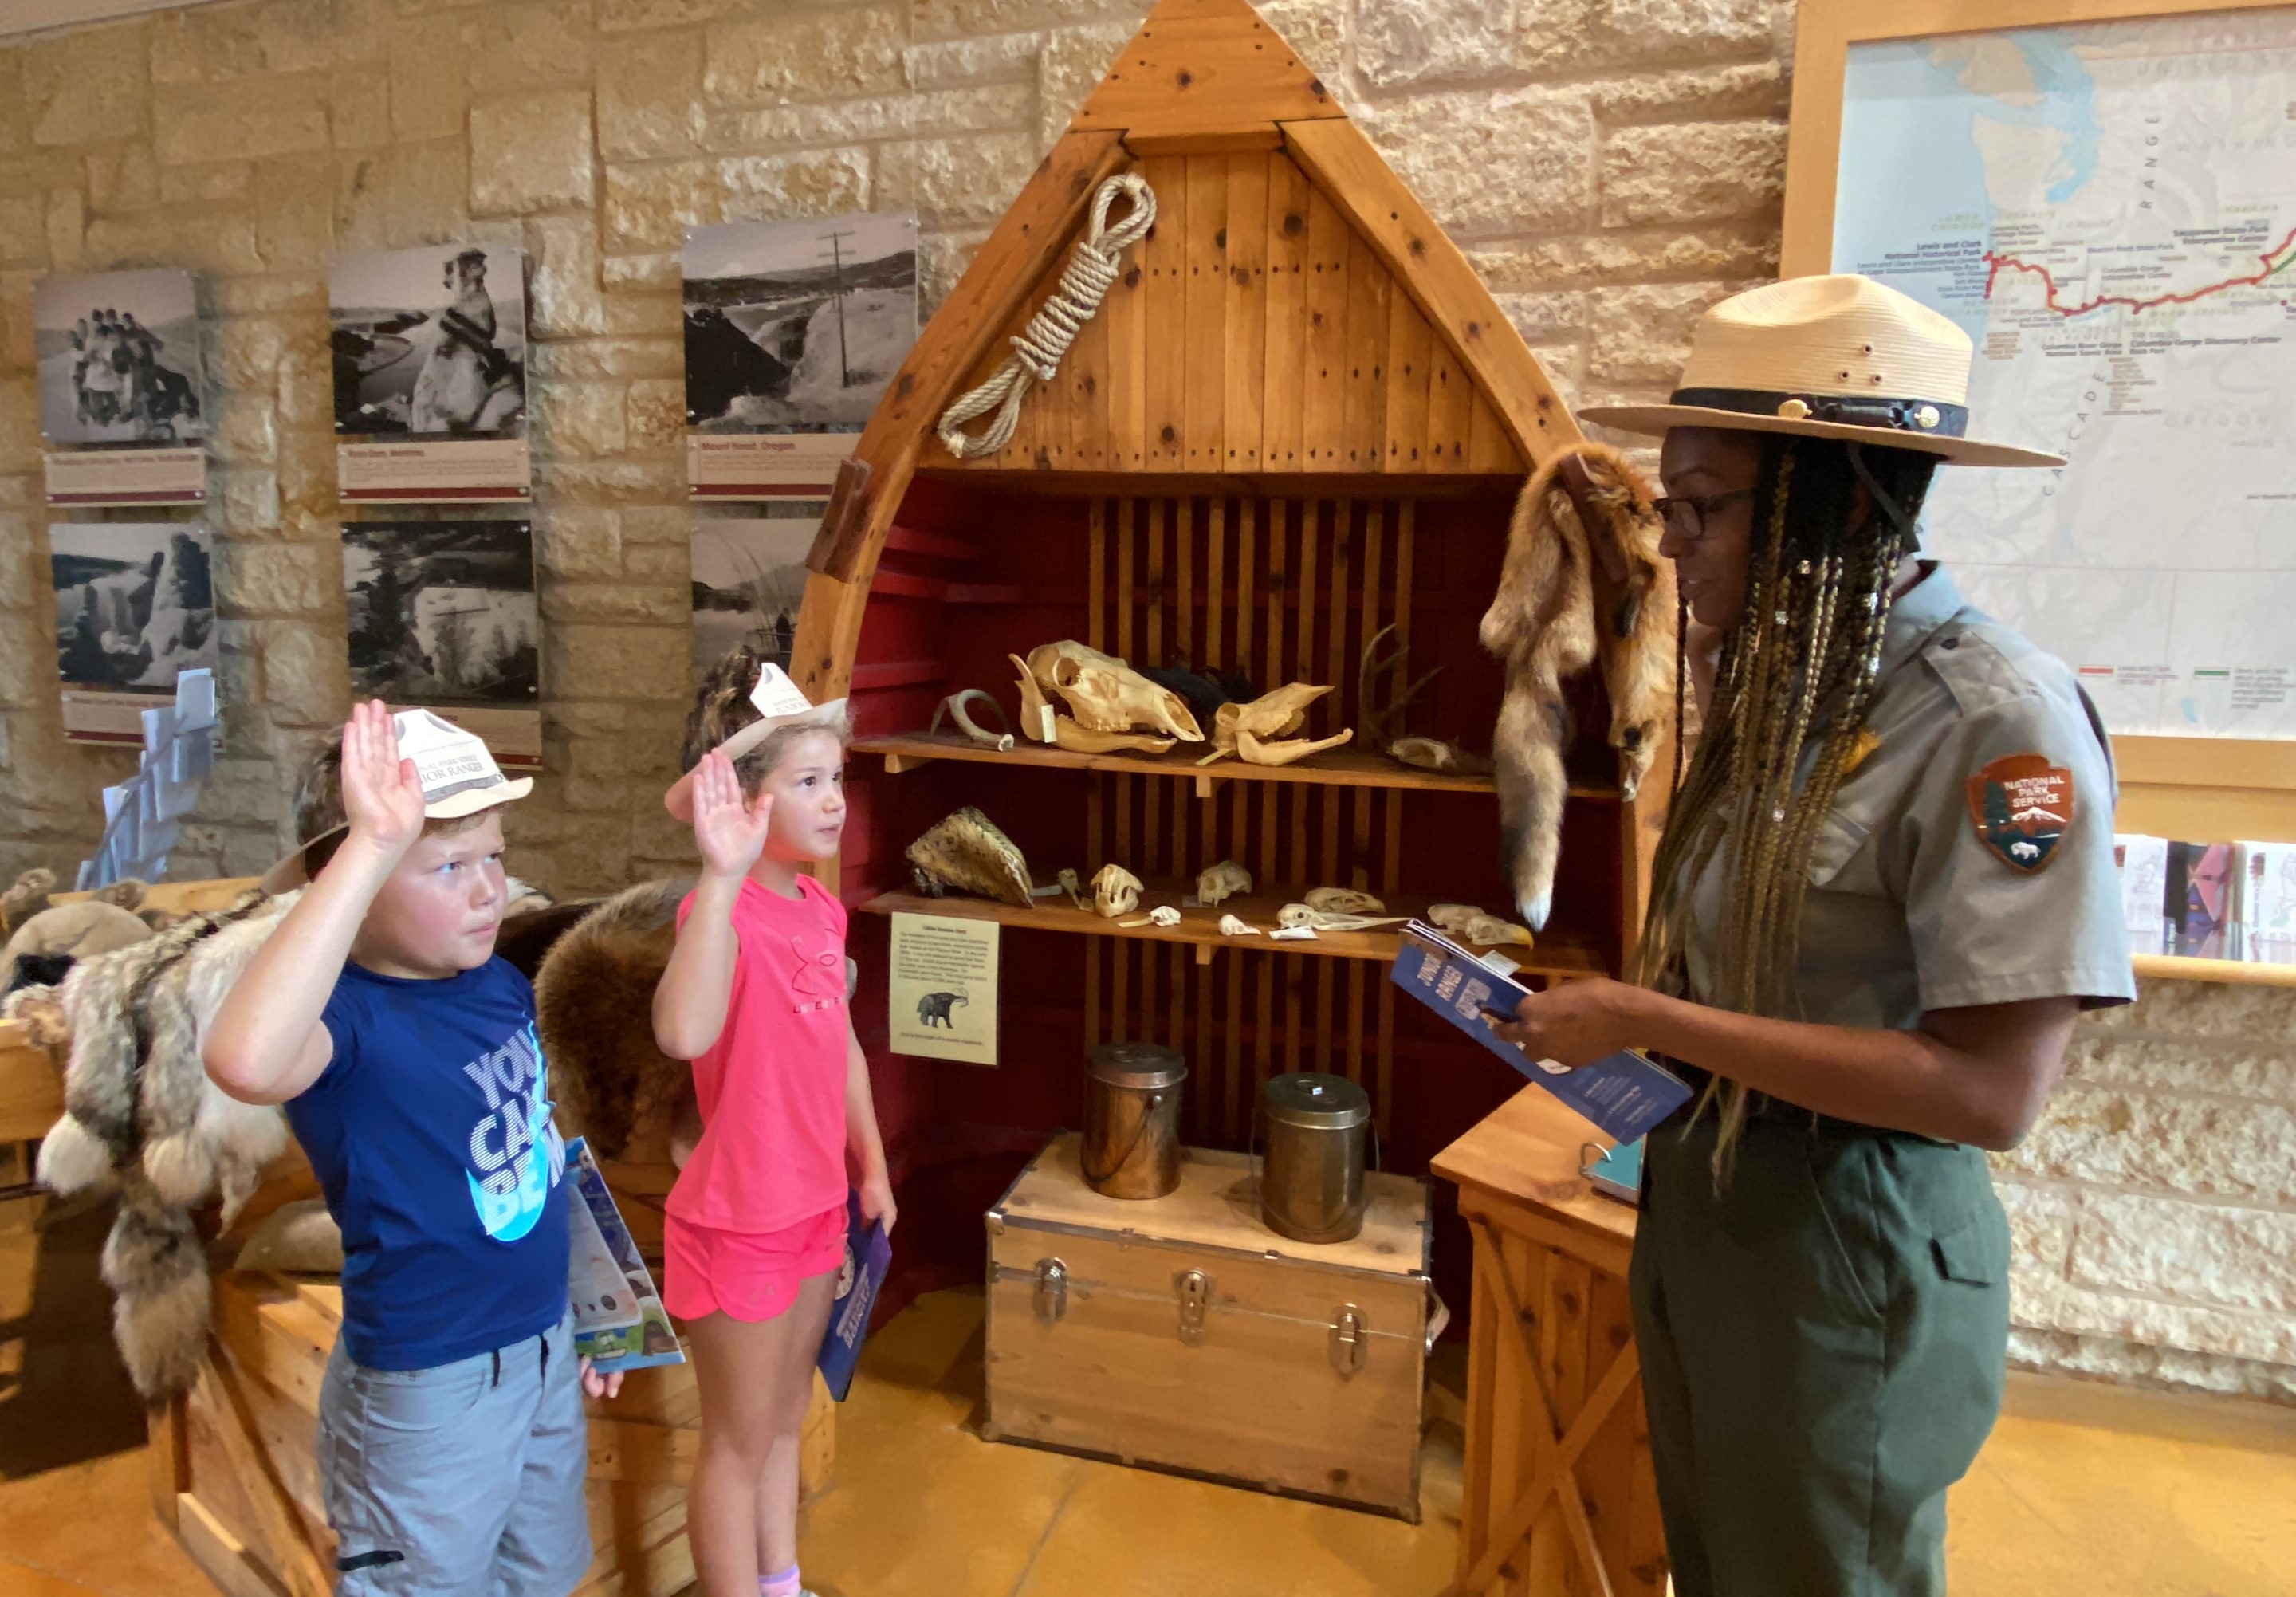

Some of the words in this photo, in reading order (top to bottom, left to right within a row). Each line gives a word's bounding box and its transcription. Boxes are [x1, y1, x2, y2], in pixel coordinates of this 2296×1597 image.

[2140, 117, 2160, 209] RANGE
[421, 769, 447, 784] IOR
[2004, 776, 2064, 790] NATIONAL
[2018, 786, 2050, 797] PARK
[2012, 793, 2060, 808] SERVICE
[463, 1029, 537, 1110] YOU
